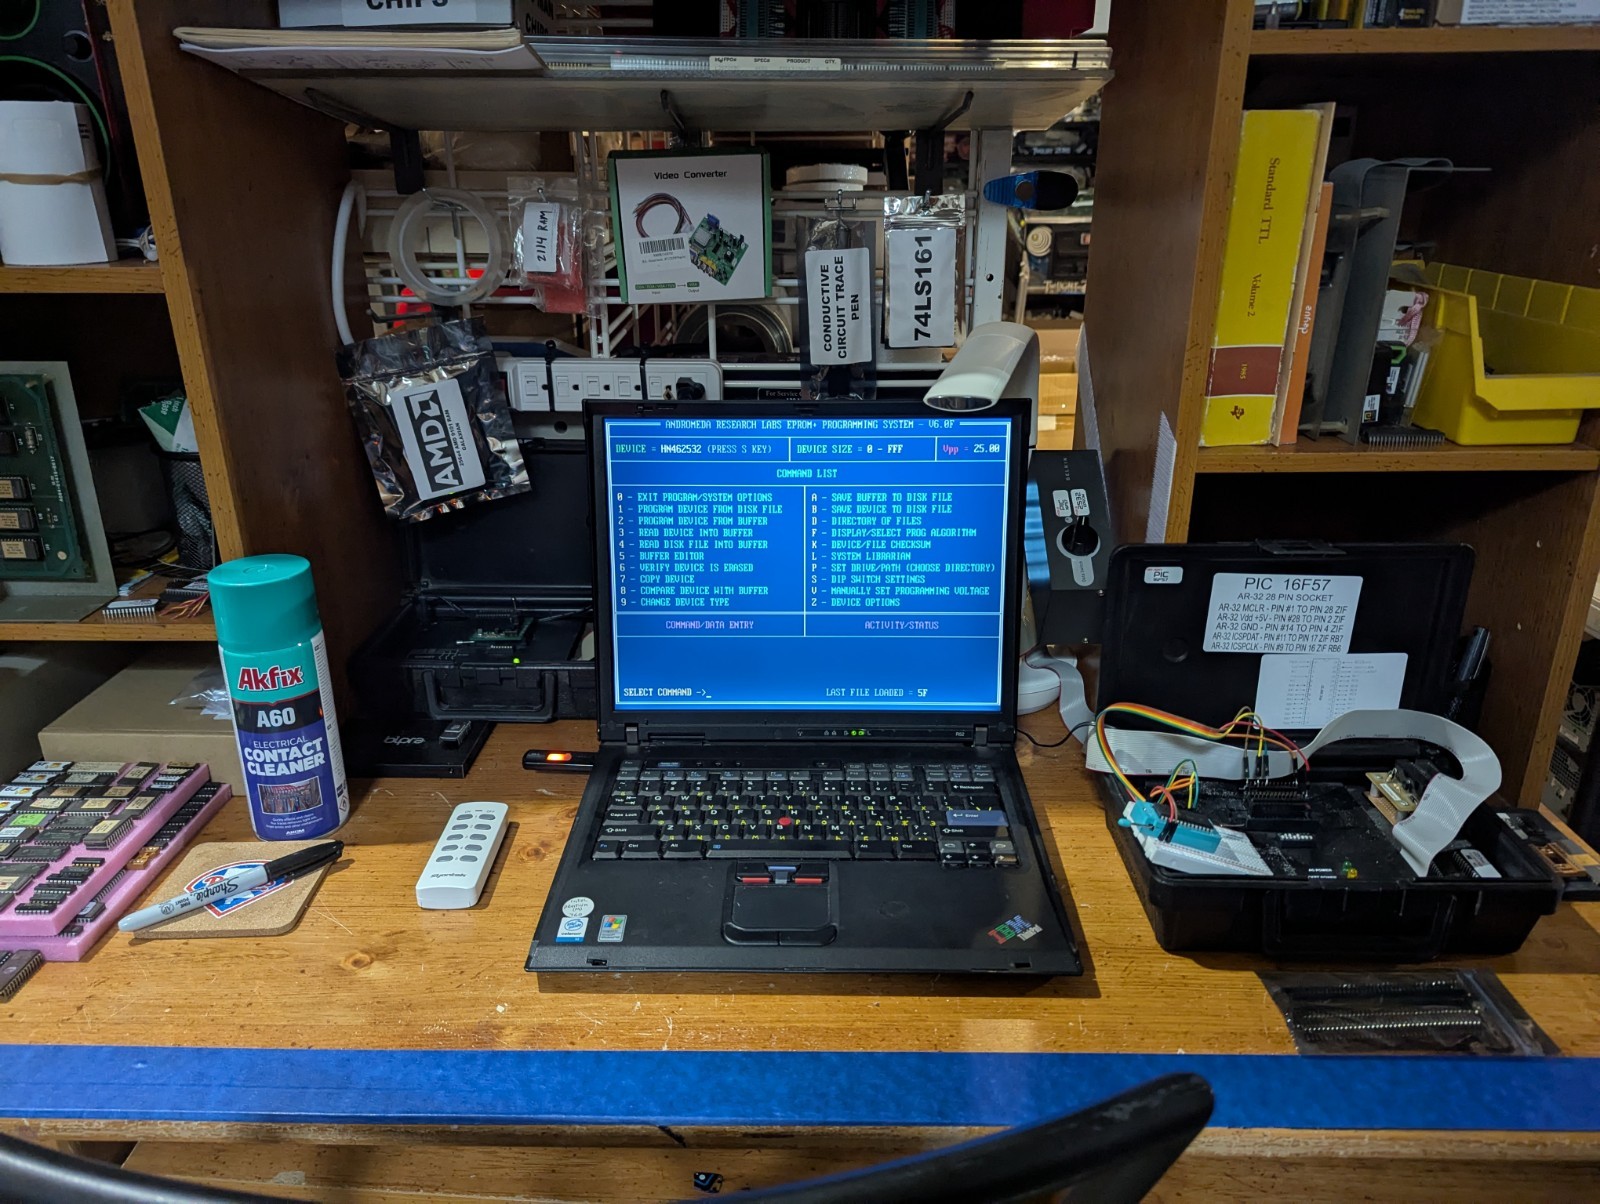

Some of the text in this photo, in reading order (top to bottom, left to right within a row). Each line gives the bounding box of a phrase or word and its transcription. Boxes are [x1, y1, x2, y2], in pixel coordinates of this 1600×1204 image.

[653, 169, 728, 180] Video Converter
[1263, 157, 1280, 211] Standard
[1258, 215, 1272, 245] TTL
[535, 210, 553, 262] 2114 RAM
[914, 235, 933, 341] 74LS161
[1247, 273, 1263, 310] Volume
[820, 264, 833, 352] CONDUCTIVE
[834, 255, 848, 360] CIRCUIT TRACE
[851, 293, 860, 321] PEN
[665, 420, 955, 429] ANDROMEDA RESEARCH LABS EPROM+ PROGRAMMING SYSTEM V6.0F
[420, 419, 460, 486] AMD
[615, 444, 646, 454] DEVICE
[660, 444, 702, 454] HN462532
[706, 444, 737, 454] (PRESS
[751, 444, 772, 454] KEY)
[796, 444, 828, 454] DEVICE
[832, 444, 853, 454] SIZE
[887, 444, 904, 454] FFF
[942, 444, 1000, 455] Vpp 25.00
[776, 469, 838, 478] COMMAND LIST
[637, 493, 773, 502] EXIT PROGRAM/SYSTEM OPTIONS
[831, 493, 953, 502] SAVE BUFFER TO DISK FILE
[637, 505, 783, 514] PROGRAM DEVICE FROM DISK FILE
[831, 517, 922, 526] DIRECTORY OF FILES
[638, 529, 753, 537] READ DEVICE INTO BUFFER
[831, 528, 977, 537] DISPLAY/SELECT PROG ALGORITHM
[831, 540, 932, 549] DEVICE/FILE CHECKSUM
[639, 552, 705, 561] BUFFER EDITOR
[831, 552, 911, 561] SYSTEM LIBRARIAN
[831, 563, 996, 573] SET DRIVE/PATH (CHOOSE DIRECTORY)
[640, 575, 695, 584] COPY DEVICE
[831, 575, 926, 584] DIP SWITCH SETTINGS
[1244, 577, 1332, 591] PIC 16F57
[640, 586, 769, 595] COMPARE DEVICE WITH BUFFER
[831, 587, 990, 596] MANUALLY SET PROGRAMMING VOLTAGE
[831, 598, 901, 607] DEVICE OPTIONS
[1237, 593, 1264, 601] AR-32
[1265, 593, 1276, 601] 28
[1295, 594, 1335, 602] SOCKET
[1218, 603, 1349, 614] AR-32 MCLR PIN #1 TO PIN 28 ZIF
[1217, 613, 1240, 622] AR-32
[1240, 613, 1254, 622] Vdd
[1254, 614, 1269, 622] +5V
[1273, 614, 1287, 622] PIN
[1287, 614, 1301, 623] #28
[1302, 615, 1312, 623] TO
[1312, 615, 1326, 623] PIN
[1333, 615, 1346, 624] ZIF
[665, 620, 754, 629] COMMAND/DATA ENTRY
[864, 621, 940, 630] ACTIVITY/STATUS
[1215, 622, 1240, 631] AR-32
[1240, 622, 1259, 631] GND
[1264, 623, 1279, 632] PIN
[1280, 623, 1294, 632] #14
[1296, 624, 1307, 632] TO
[1308, 624, 1323, 632] PIN
[1330, 624, 1344, 633] ZIF
[237, 664, 305, 692] Akfix
[623, 688, 692, 697] SELECT COMMAND
[826, 688, 846, 697] LAST
[850, 688, 870, 697] FILE
[874, 688, 904, 697] LOADED
[257, 707, 296, 728] A60
[253, 735, 309, 749] ELECTRICAL
[244, 737, 323, 764] CONTACT
[247, 751, 326, 777] CLEANER
[196, 875, 239, 902] Sharpie
[987, 914, 1044, 945] IBM ThinkPad
